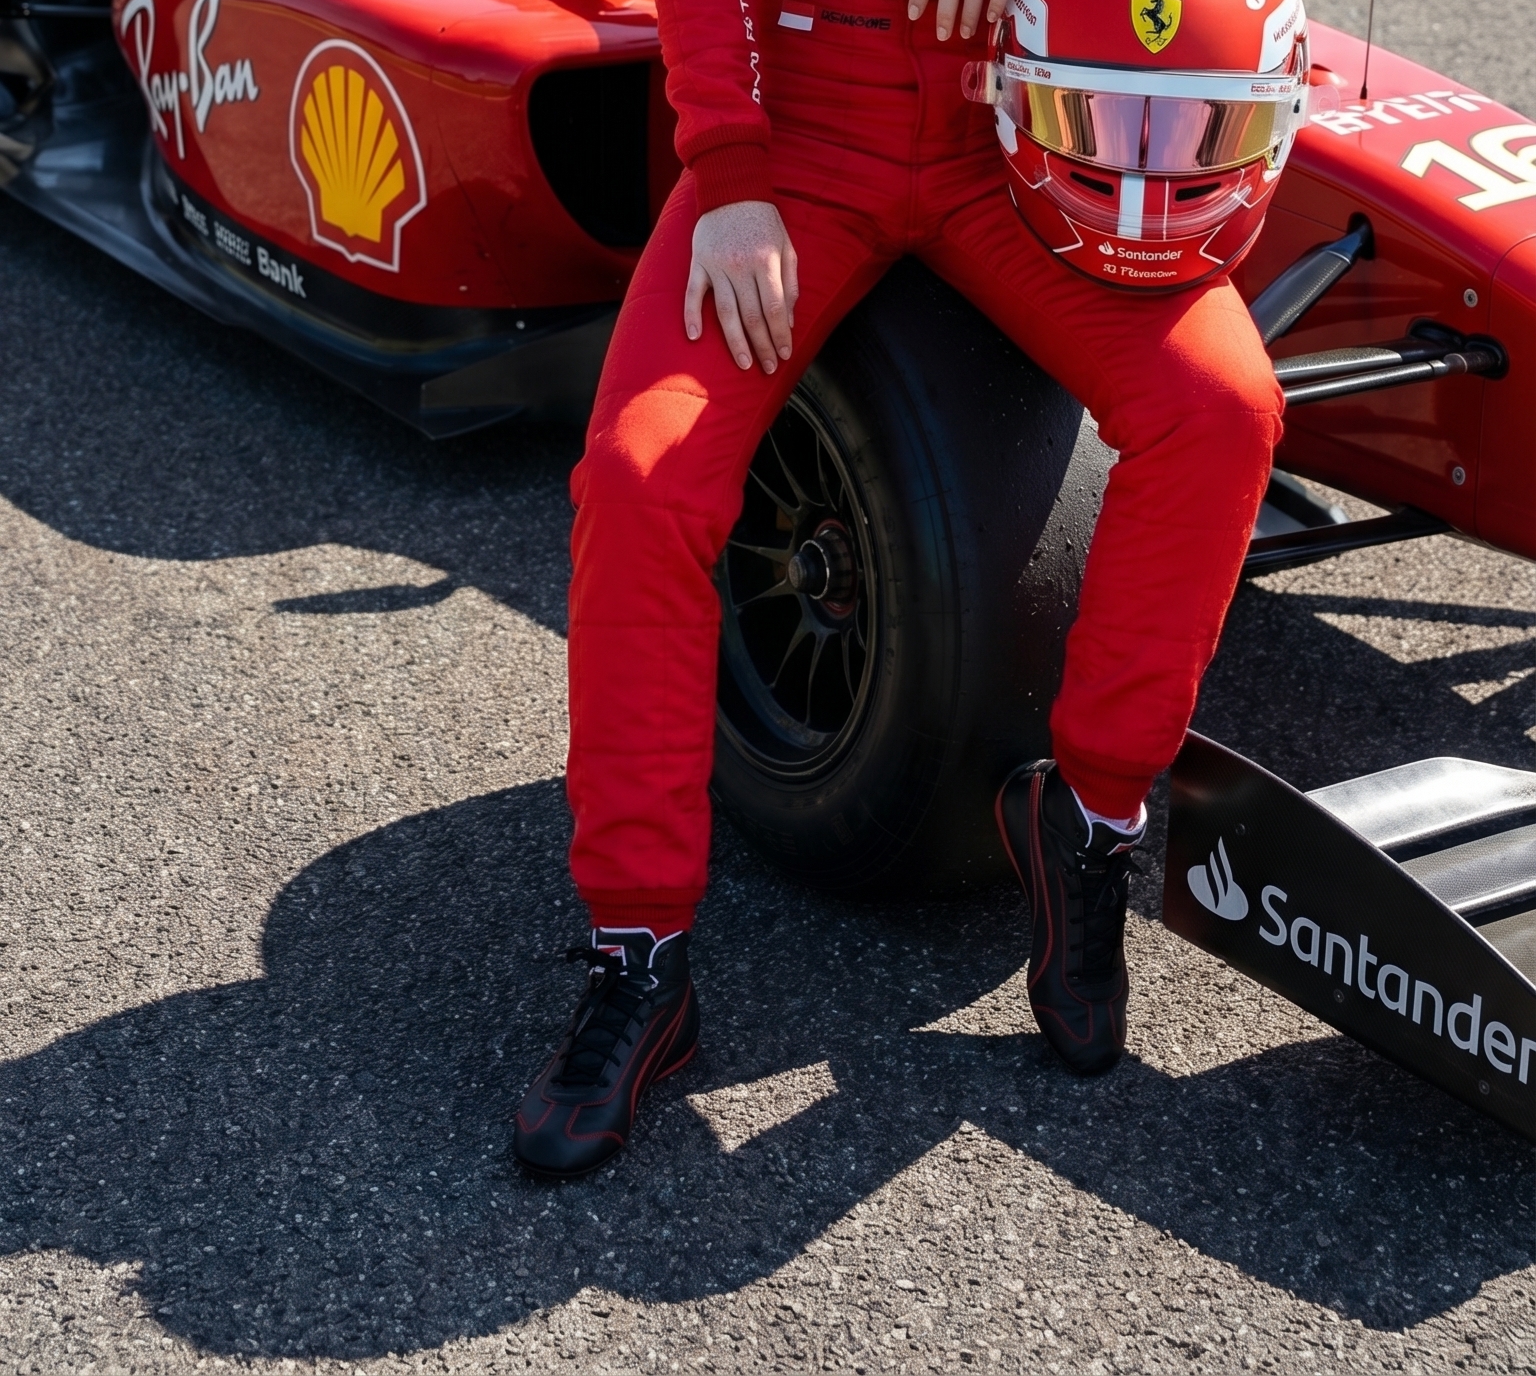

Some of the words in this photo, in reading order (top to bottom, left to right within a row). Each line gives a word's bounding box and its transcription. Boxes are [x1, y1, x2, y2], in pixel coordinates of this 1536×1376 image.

[256, 245, 307, 299] Bank
[1117, 247, 1183, 261] Santander
[1259, 884, 1536, 1085] Santander
